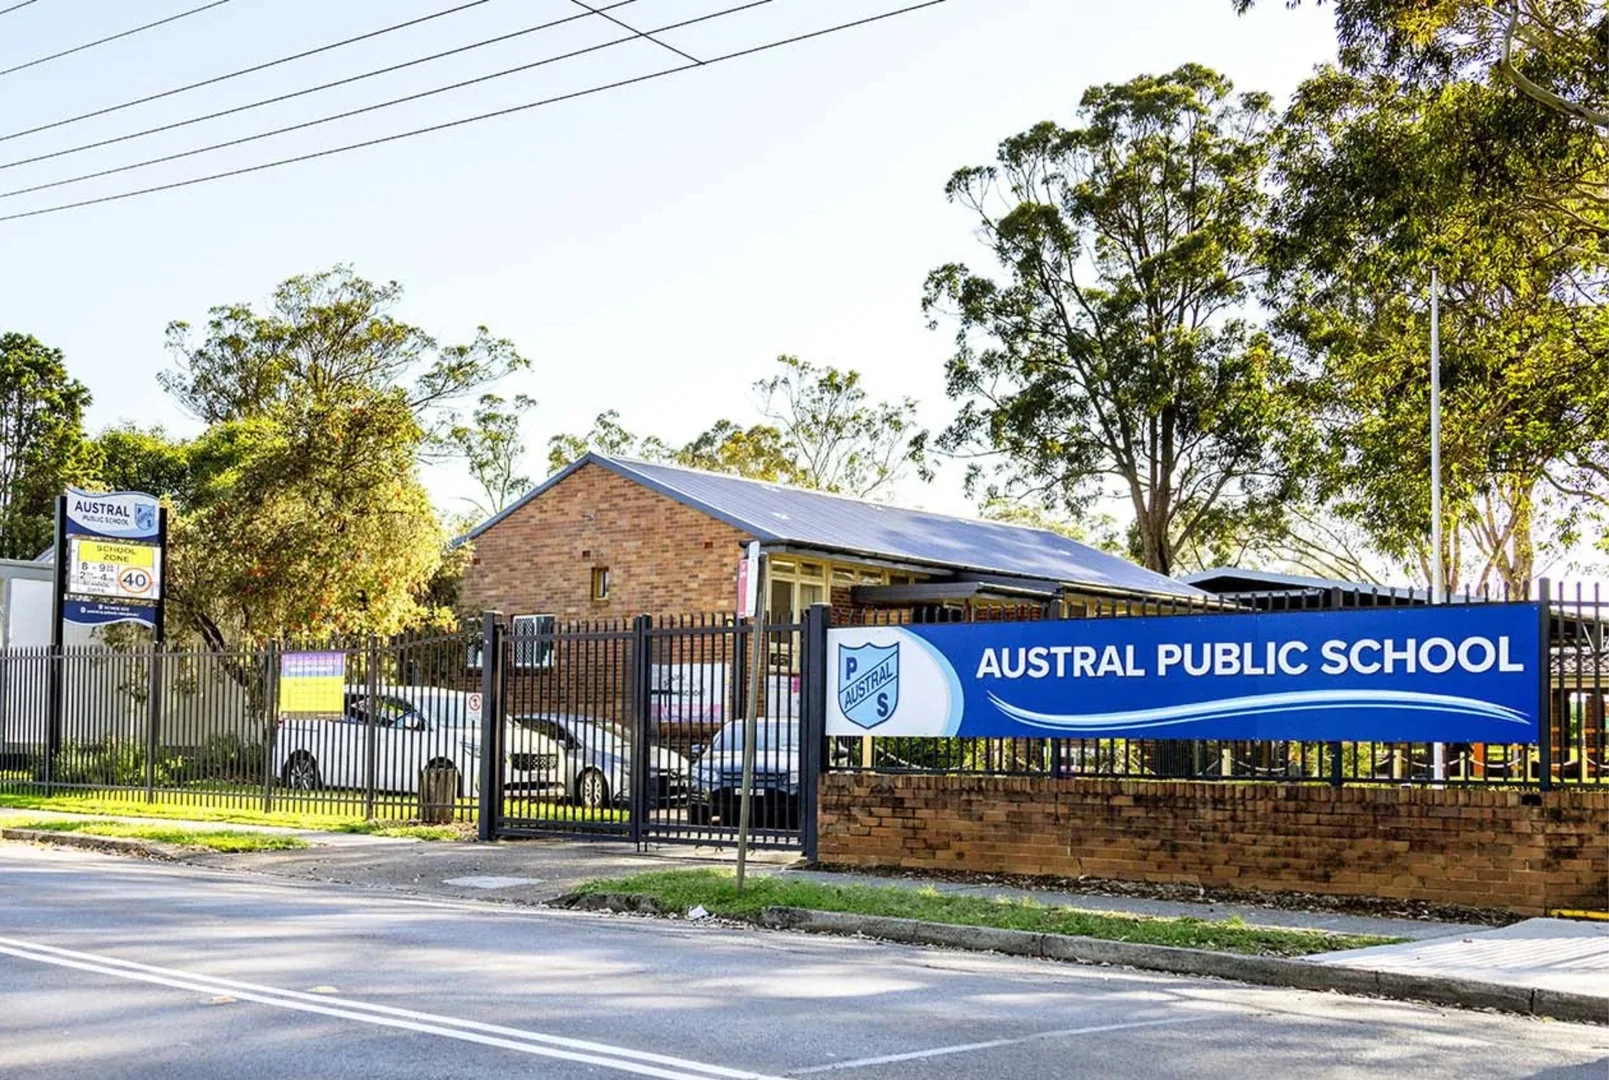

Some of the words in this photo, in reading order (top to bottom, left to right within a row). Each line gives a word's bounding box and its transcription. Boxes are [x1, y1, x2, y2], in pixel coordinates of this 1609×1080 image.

[75, 500, 130, 517] AUSTRAL
[96, 545, 136, 555] SCHOOL
[103, 554, 130, 562] ZONE
[122, 573, 147, 588] 40
[976, 644, 1146, 679] AUSTRAL
[1157, 641, 1309, 677] PUBLIC
[1320, 636, 1525, 675] SCHOOL
[846, 656, 858, 680] P
[844, 662, 893, 709] AUSTRAL
[876, 692, 889, 718] S
